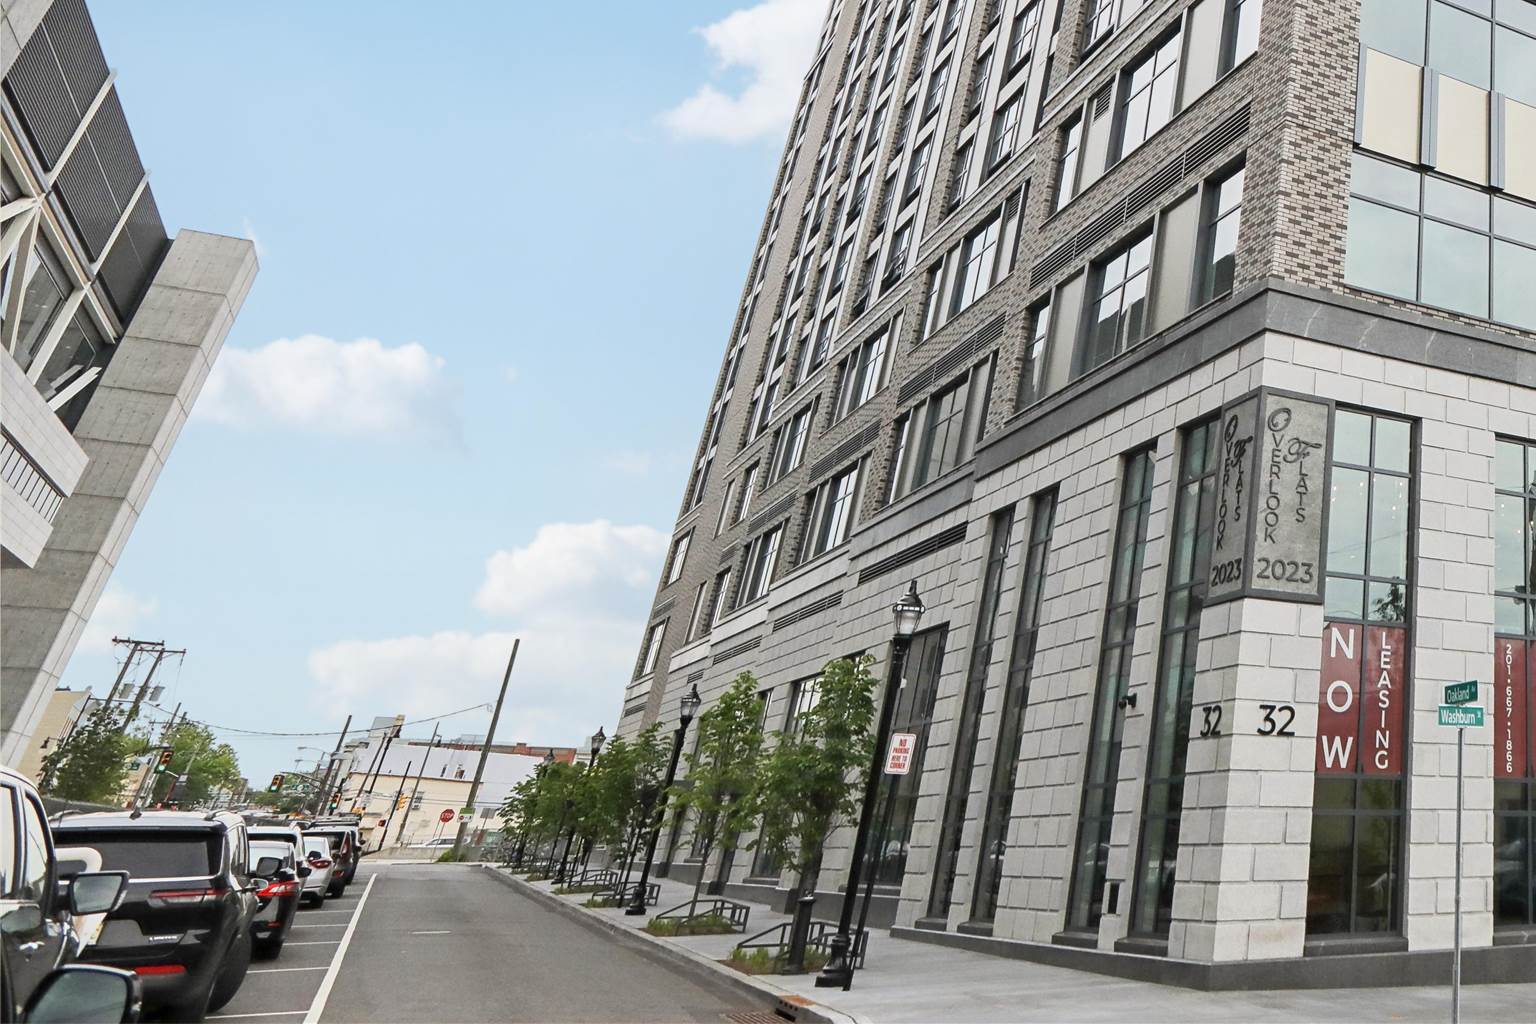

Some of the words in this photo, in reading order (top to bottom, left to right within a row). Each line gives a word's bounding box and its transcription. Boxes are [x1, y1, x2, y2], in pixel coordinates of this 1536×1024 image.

[1216, 415, 1238, 550] OVERLOOK
[1264, 407, 1292, 544] OVERLOOK
[1283, 436, 1322, 523] FLATS
[1211, 558, 1242, 587] 2023
[1256, 557, 1314, 584] 2023
[1322, 627, 1355, 769] NOW
[1374, 631, 1391, 770] LEASING
[1446, 685, 1470, 703] Oakland
[1200, 705, 1222, 737] 32
[1257, 704, 1295, 736] 32
[1440, 708, 1476, 725] Washburn
[899, 738, 908, 747] NO
[440, 811, 455, 820] STOP
